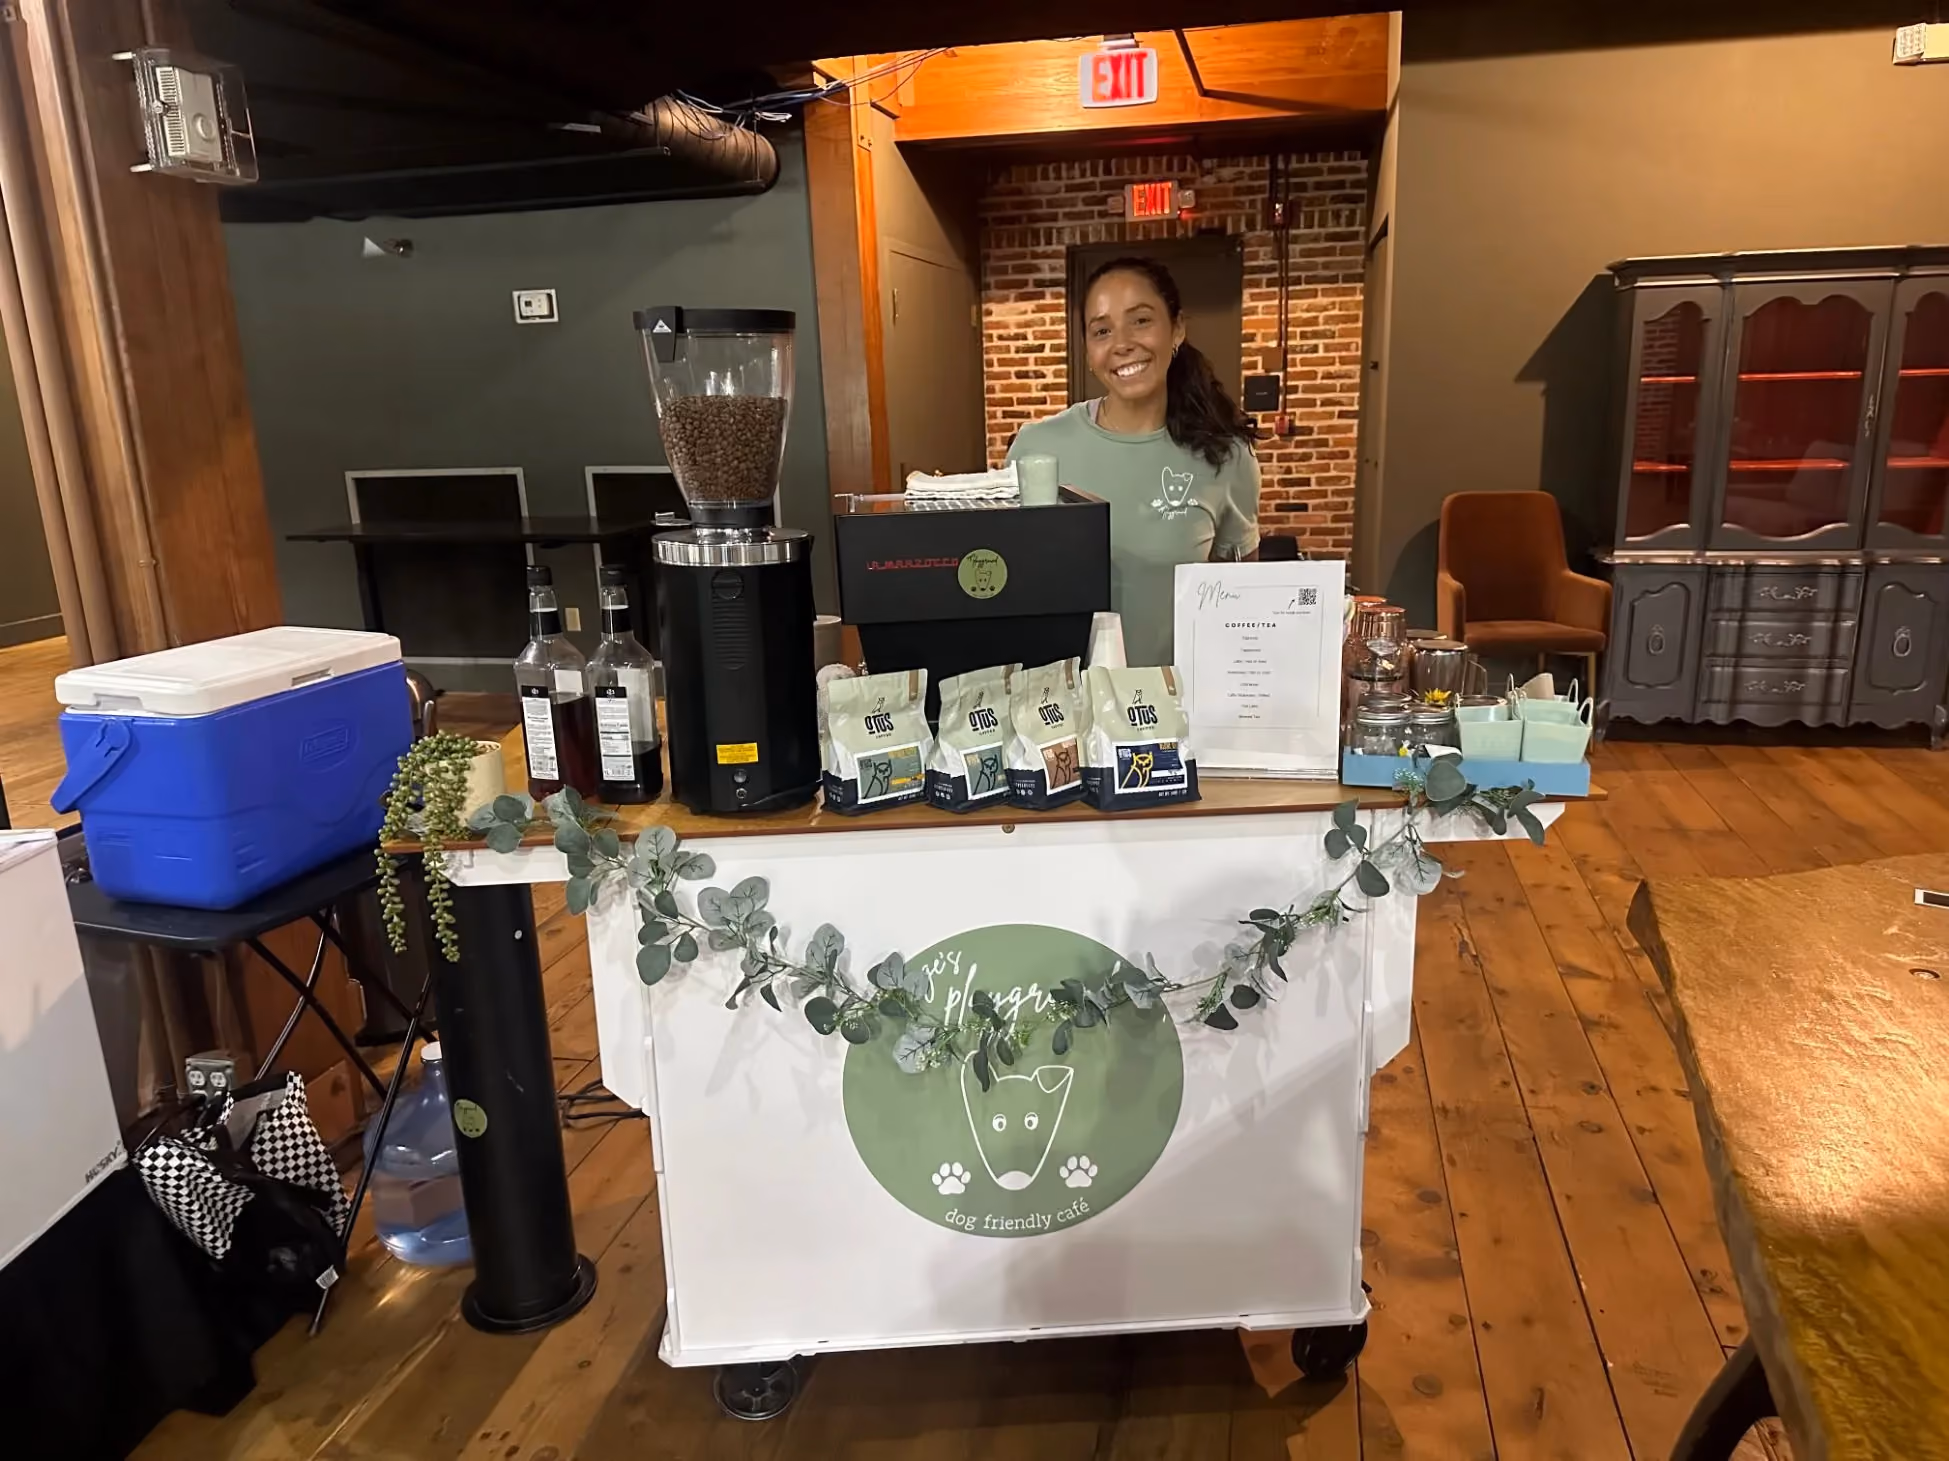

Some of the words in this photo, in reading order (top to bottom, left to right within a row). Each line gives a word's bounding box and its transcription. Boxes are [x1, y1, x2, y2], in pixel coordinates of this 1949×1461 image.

[1091, 53, 1148, 102] EXIT
[1133, 182, 1172, 217] EXIT
[1197, 581, 1241, 610] Menu
[864, 712, 894, 735] OTUS
[968, 707, 999, 732] OTUS
[1038, 703, 1065, 726] OTUS
[1127, 704, 1158, 727] OTUS
[85, 1146, 118, 1184] HUSKY
[945, 1208, 977, 1231] dog
[983, 1213, 1052, 1230] friendly
[1056, 1197, 1091, 1223] café
